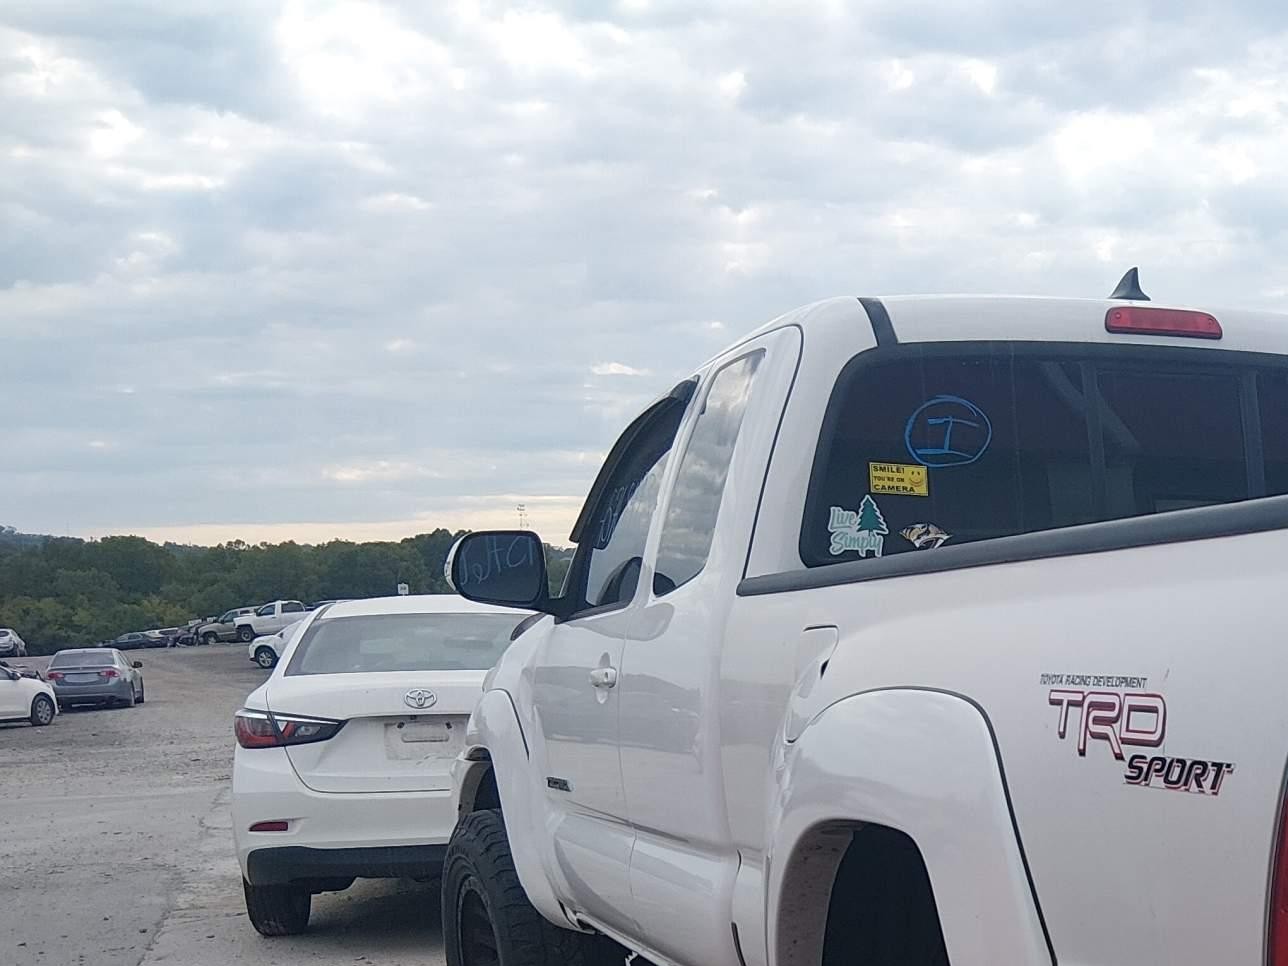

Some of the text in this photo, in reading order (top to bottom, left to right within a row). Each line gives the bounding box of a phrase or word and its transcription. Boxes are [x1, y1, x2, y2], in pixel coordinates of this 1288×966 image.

[872, 465, 905, 475] SMILE!
[873, 484, 916, 493] CAMERA
[829, 507, 858, 531] Live
[830, 531, 883, 556] Simply
[1040, 673, 1148, 689] TOYOTA RACING DEVELOPMENT
[1049, 689, 1167, 760] TRD
[1123, 754, 1235, 796] SPORT
